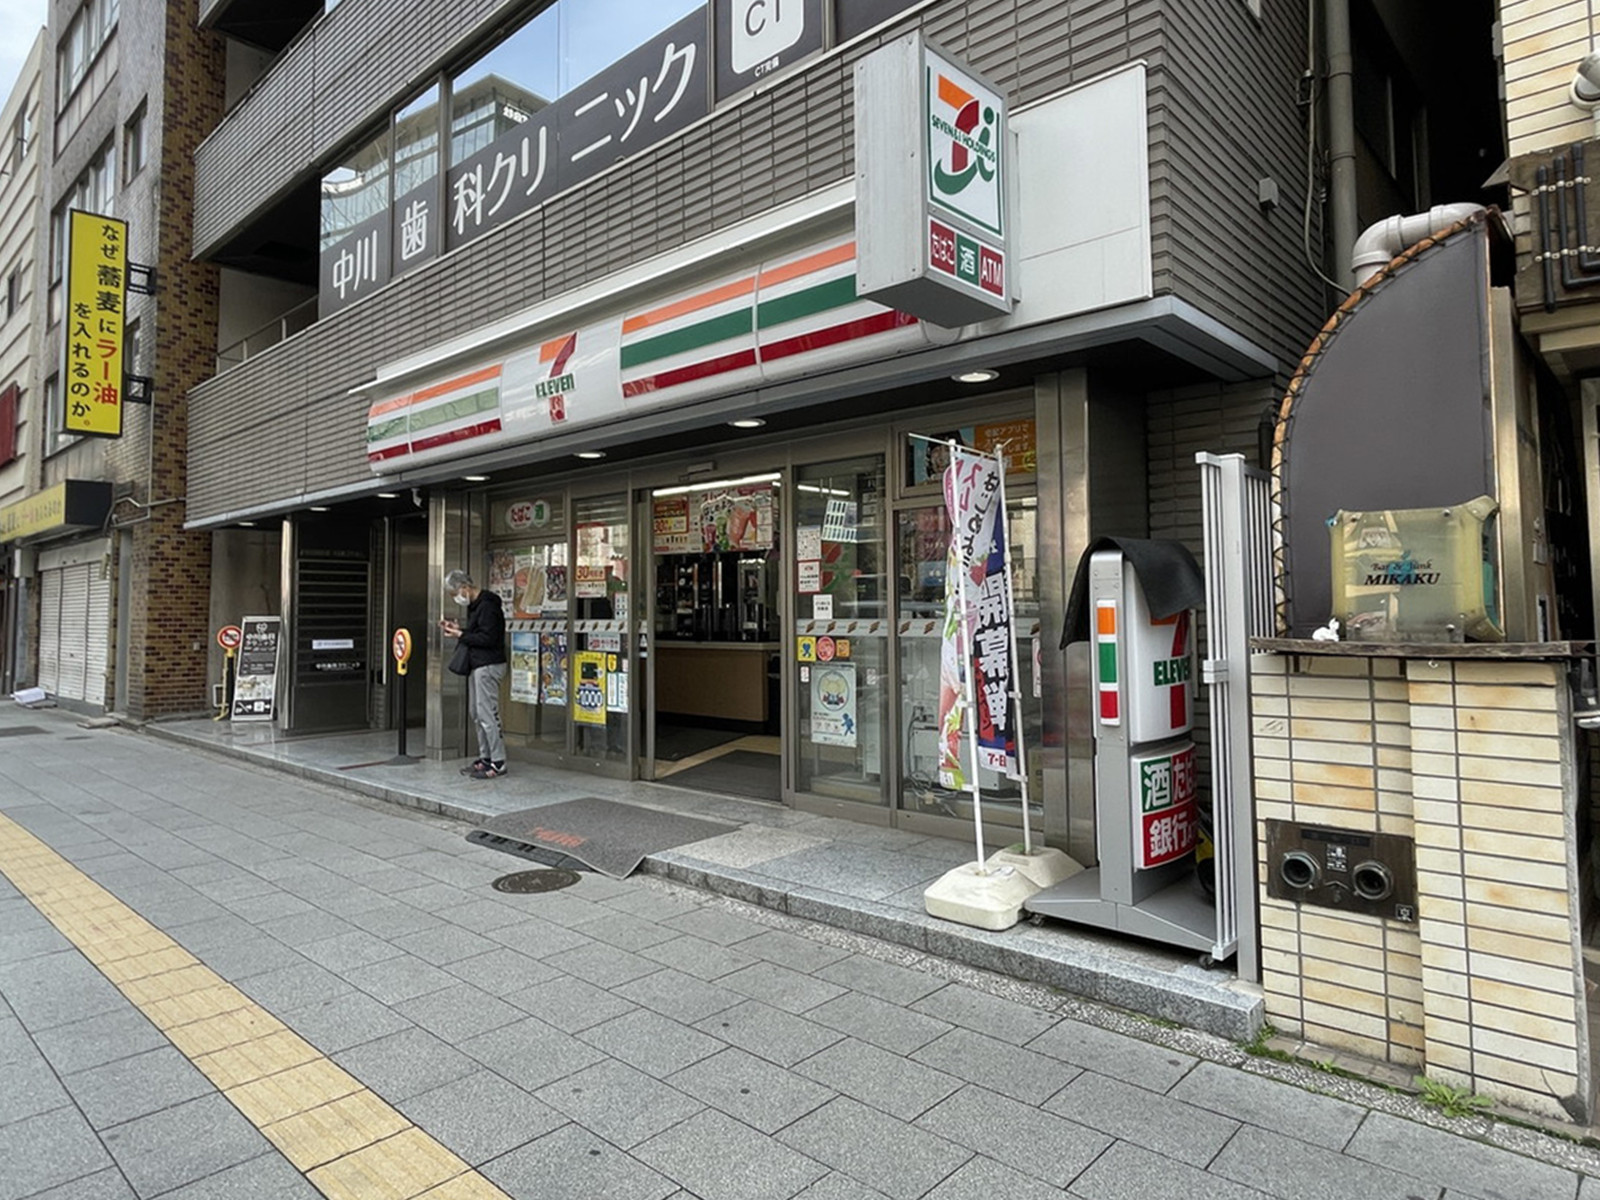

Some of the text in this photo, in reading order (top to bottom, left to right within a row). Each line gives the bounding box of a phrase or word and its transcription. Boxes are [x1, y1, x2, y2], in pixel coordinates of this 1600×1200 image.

[932, 232, 955, 266] たばこ
[960, 244, 976, 276] 酒
[981, 256, 1003, 288] ATM
[93, 223, 122, 406] なぜ蕎麦にラー油
[1364, 572, 1441, 586] MIKAKU
[1143, 761, 1171, 811] 酒
